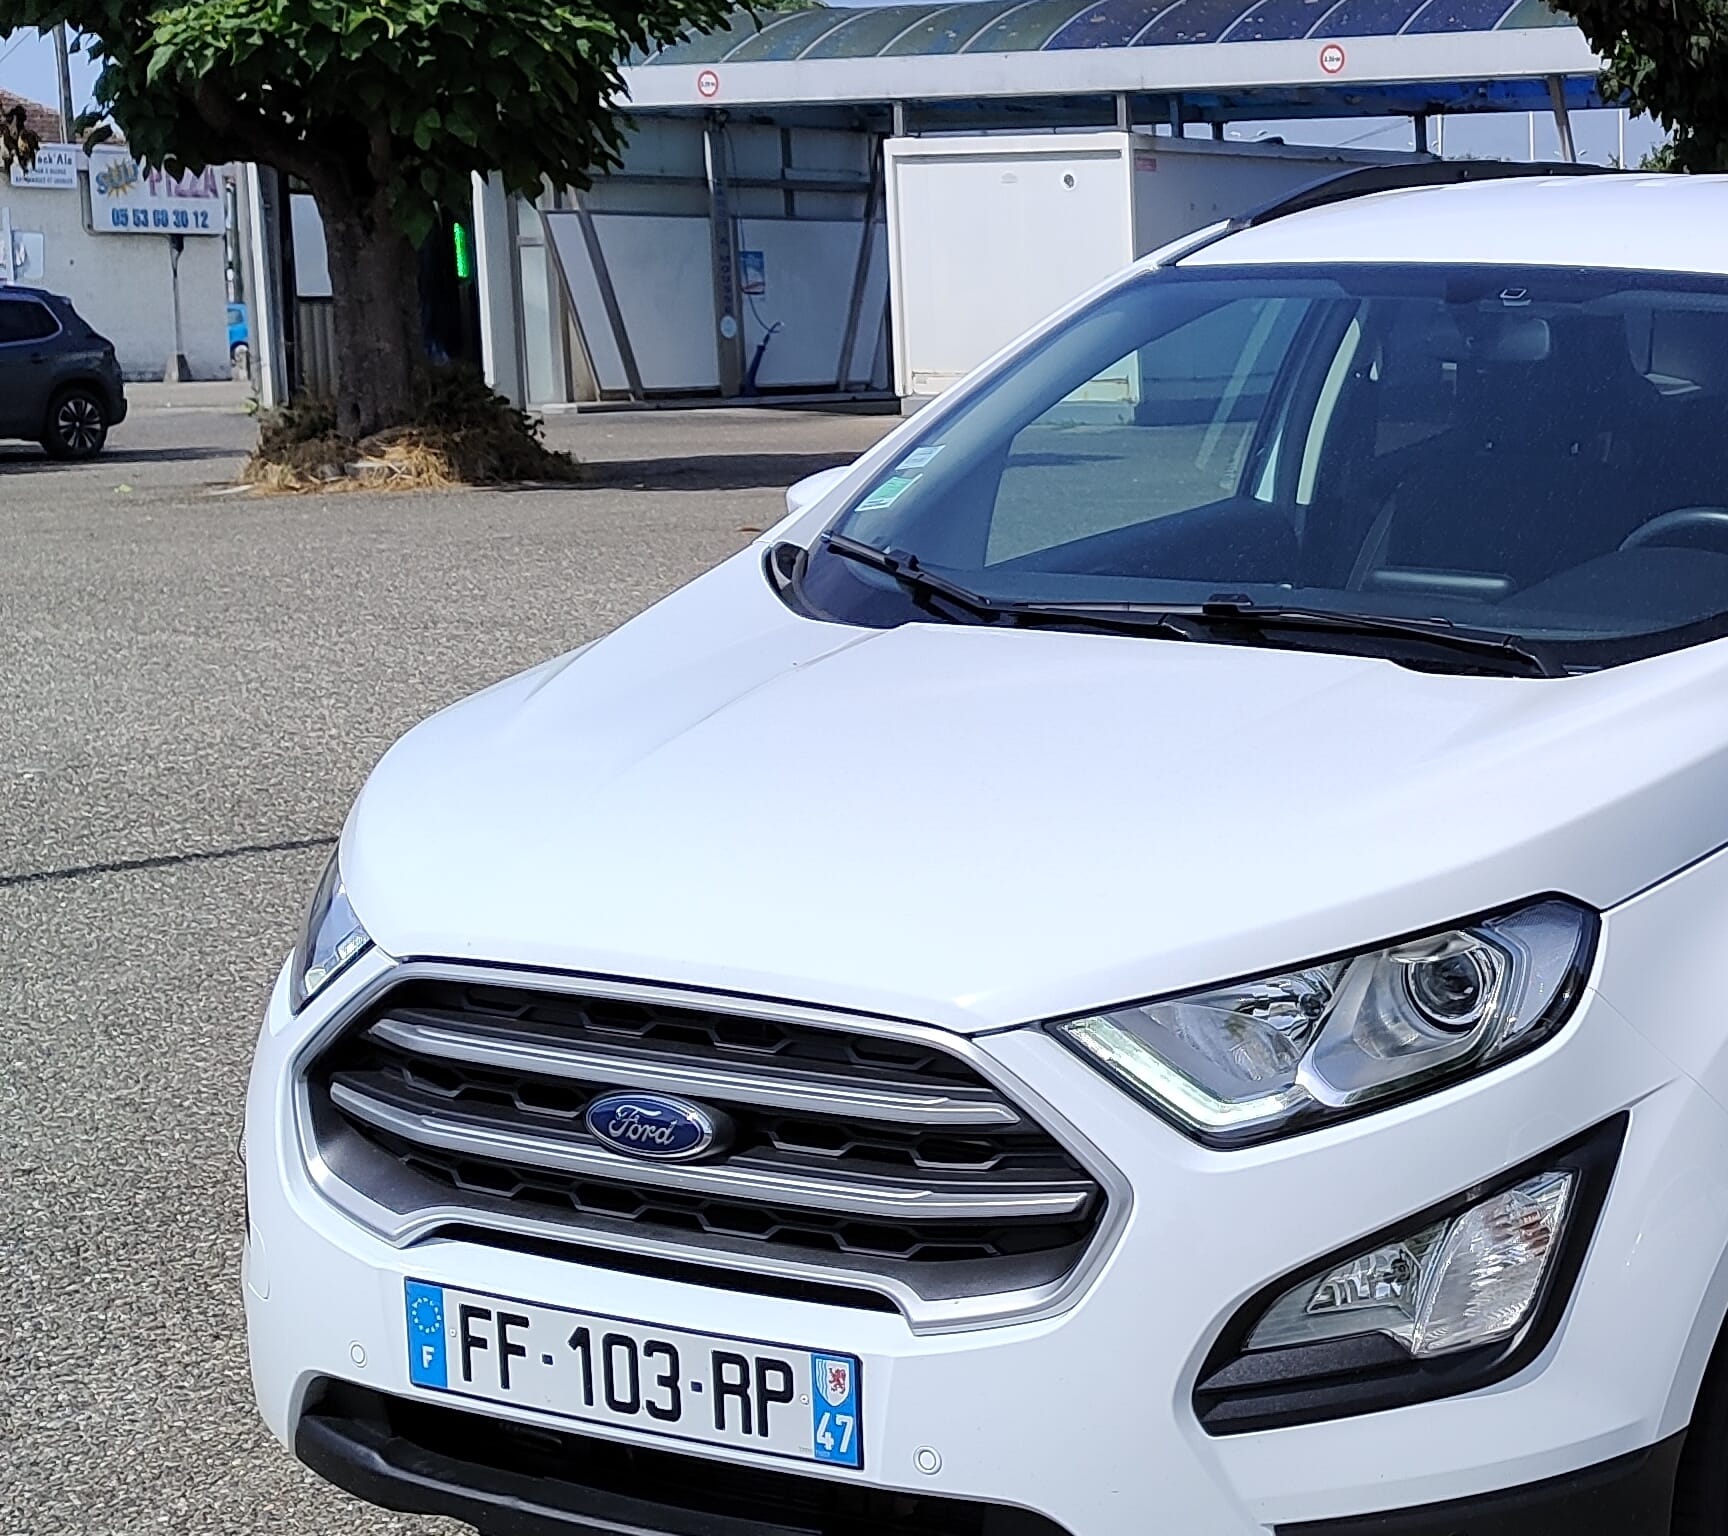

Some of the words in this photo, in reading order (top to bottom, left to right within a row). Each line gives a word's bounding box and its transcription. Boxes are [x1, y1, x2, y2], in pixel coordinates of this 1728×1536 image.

[111, 207, 129, 227] 05
[172, 208, 189, 229] 30
[192, 209, 209, 229] 12
[608, 1104, 678, 1146] Ford
[420, 1345, 435, 1370] F
[458, 1302, 795, 1438] FF-103-RP
[816, 1411, 854, 1453] 47
